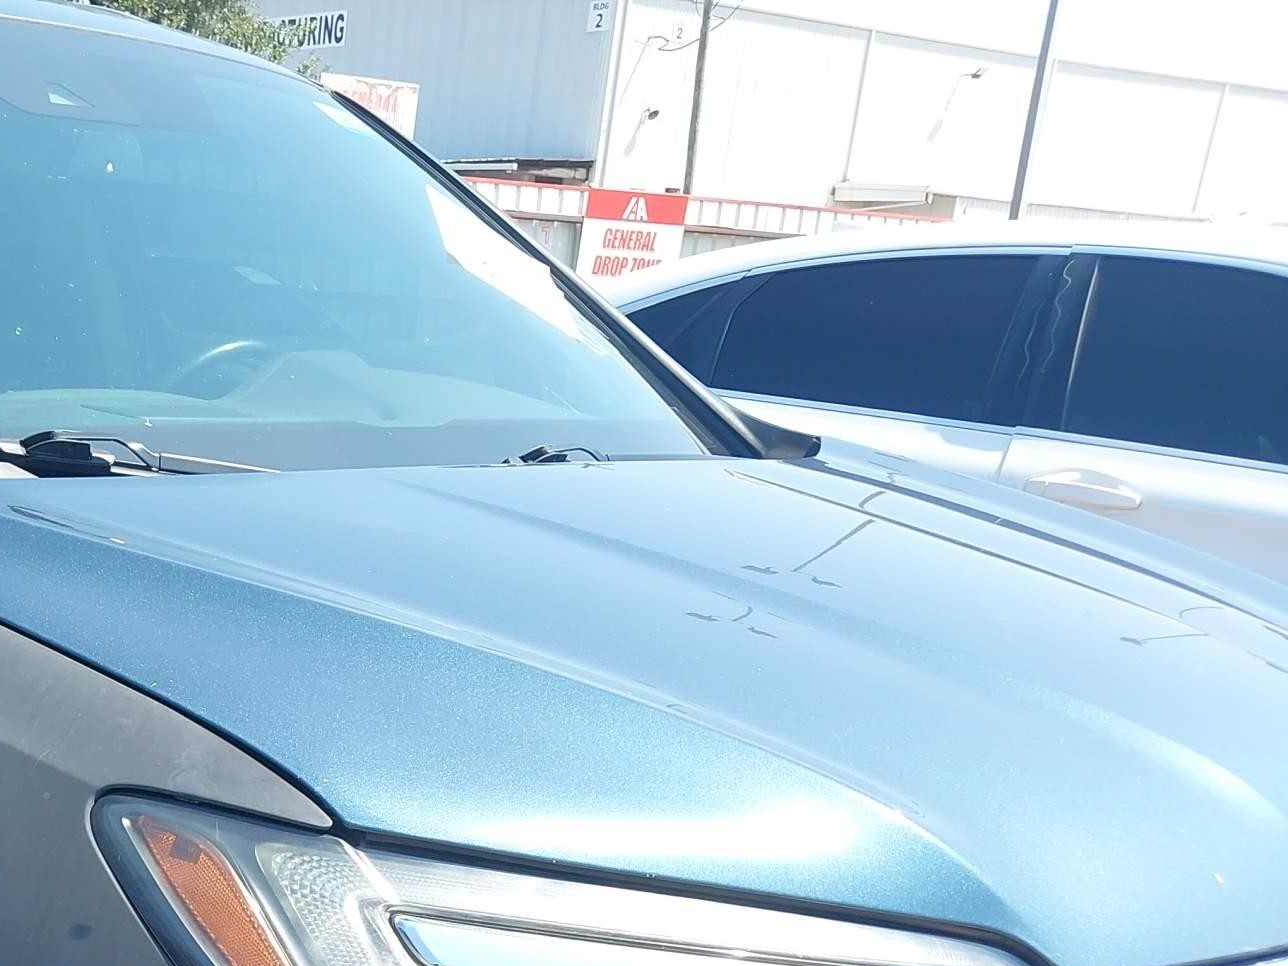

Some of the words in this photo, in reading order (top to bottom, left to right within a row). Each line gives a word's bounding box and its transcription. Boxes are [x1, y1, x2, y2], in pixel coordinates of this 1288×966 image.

[593, 2, 610, 10] BLDG
[595, 13, 604, 28] 2
[676, 27, 684, 39] 2
[602, 228, 658, 252] GENERAL
[592, 255, 629, 276] DROP
